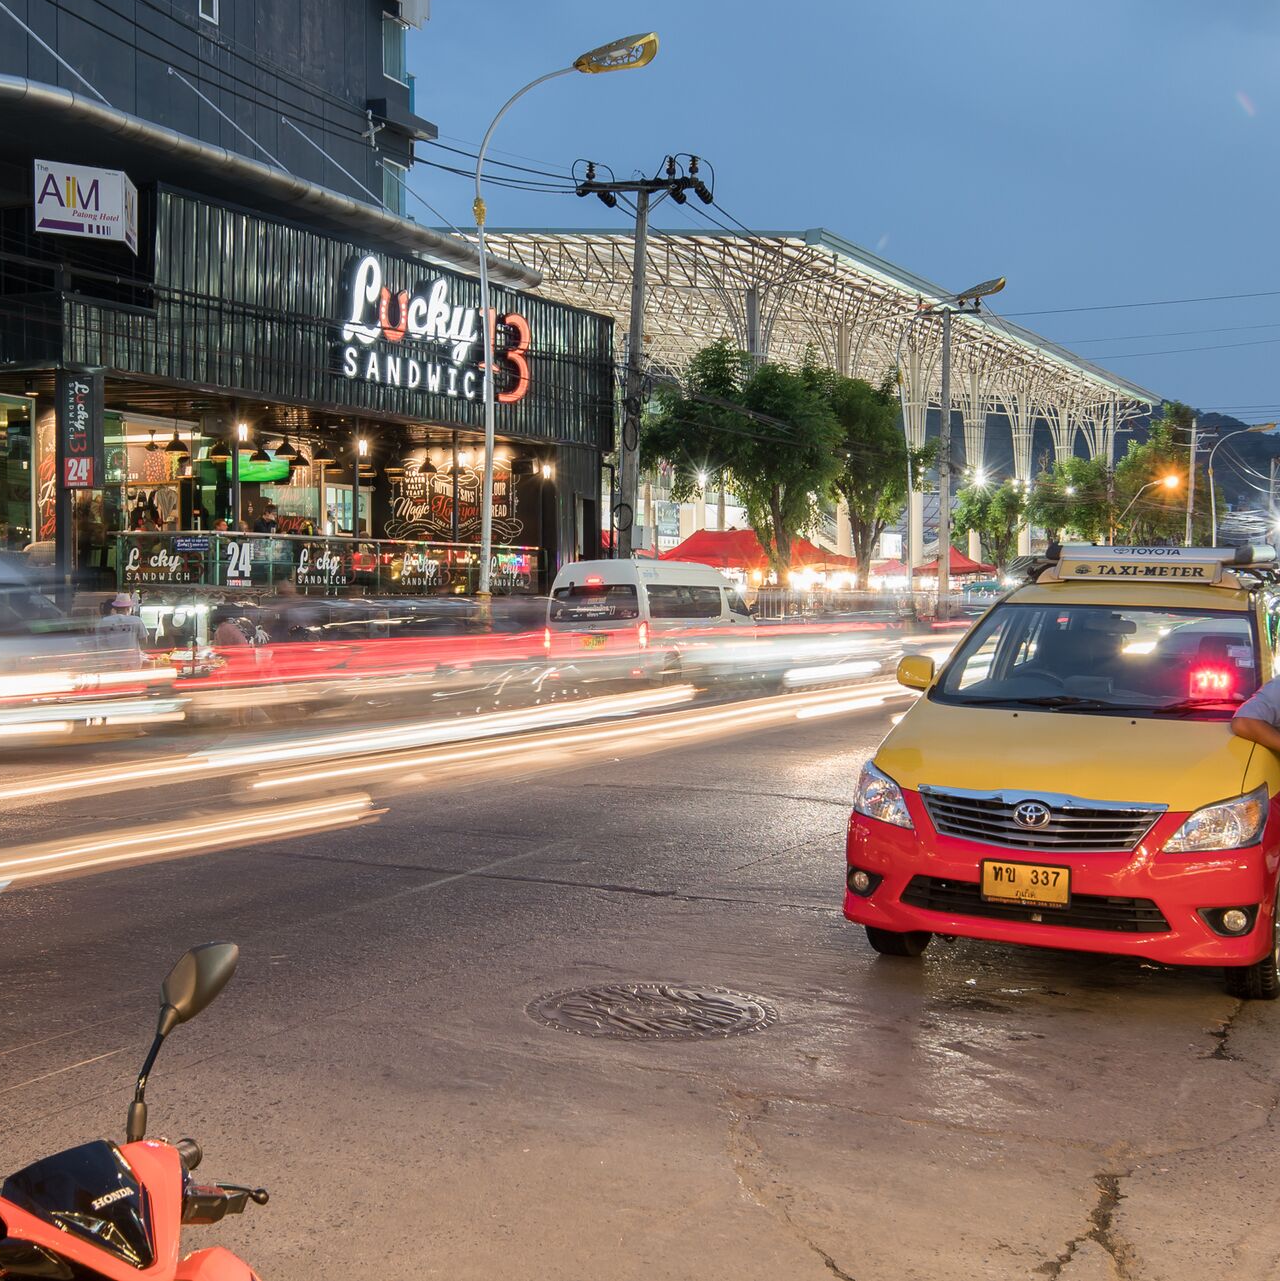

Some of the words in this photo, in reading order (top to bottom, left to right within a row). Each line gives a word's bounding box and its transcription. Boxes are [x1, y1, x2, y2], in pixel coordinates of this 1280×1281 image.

[36, 163, 49, 172] The
[72, 209, 98, 221] Patong
[99, 213, 120, 222] Hotel
[343, 255, 478, 366] Lucky
[68, 382, 76, 441] SANDWICH
[75, 381, 90, 432] Lucky
[69, 431, 88, 454] 13
[67, 458, 88, 481] 24
[460, 488, 475, 503] SAYS
[393, 496, 430, 523] Magic
[125, 547, 181, 572] Lcky
[226, 541, 252, 577] 24
[297, 548, 341, 577] Lcky
[1130, 548, 1181, 556] TOYOTA
[126, 572, 191, 581] SANDWICH
[297, 575, 347, 585] SANDWICH
[401, 577, 443, 586] SANDWICH
[1097, 564, 1204, 577] TAXI-METER
[993, 865, 1016, 883] ทข
[1030, 869, 1061, 888] 337
[91, 1186, 135, 1211] HONDA
